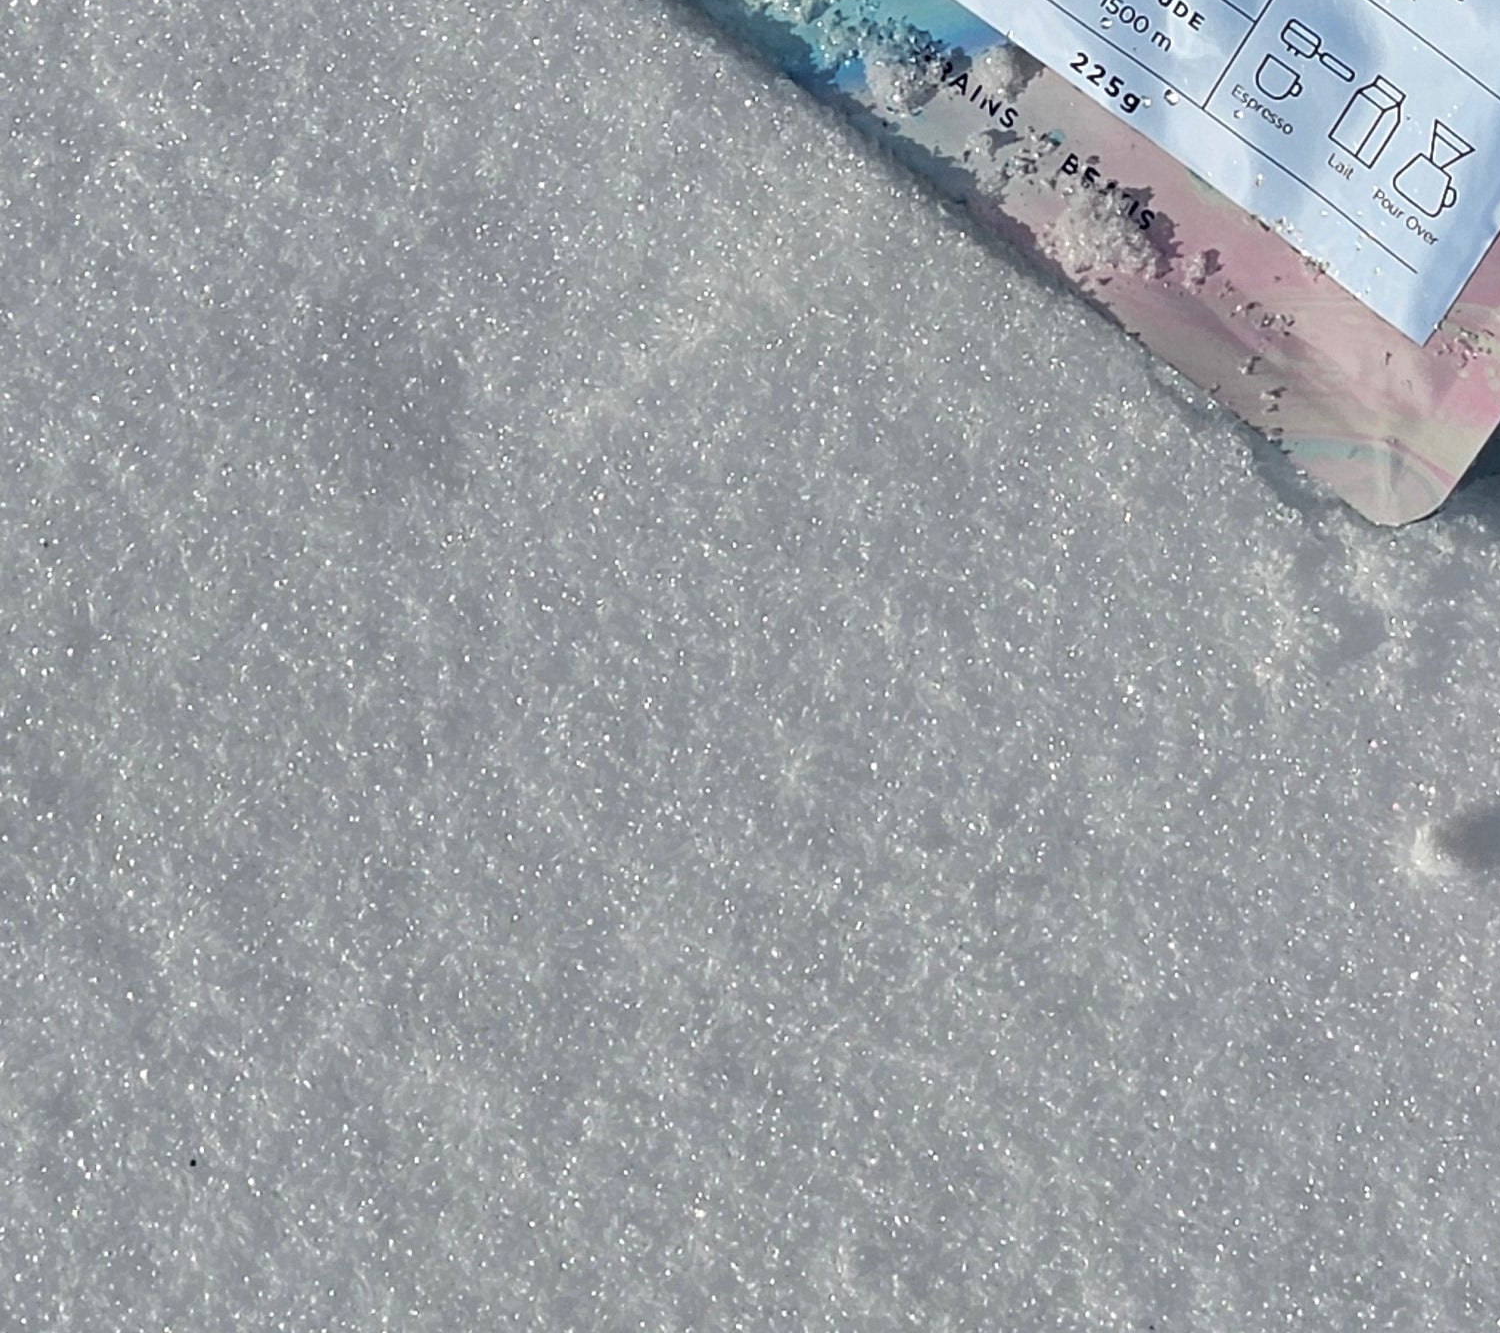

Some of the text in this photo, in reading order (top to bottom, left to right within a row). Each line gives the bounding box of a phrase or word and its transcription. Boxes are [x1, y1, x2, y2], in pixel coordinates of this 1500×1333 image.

[1151, 31, 1173, 52] m
[1069, 52, 1141, 113] 225g
[1231, 84, 1293, 135] Espresso
[1328, 153, 1355, 180] Lait
[1373, 188, 1439, 246] Pour Over
